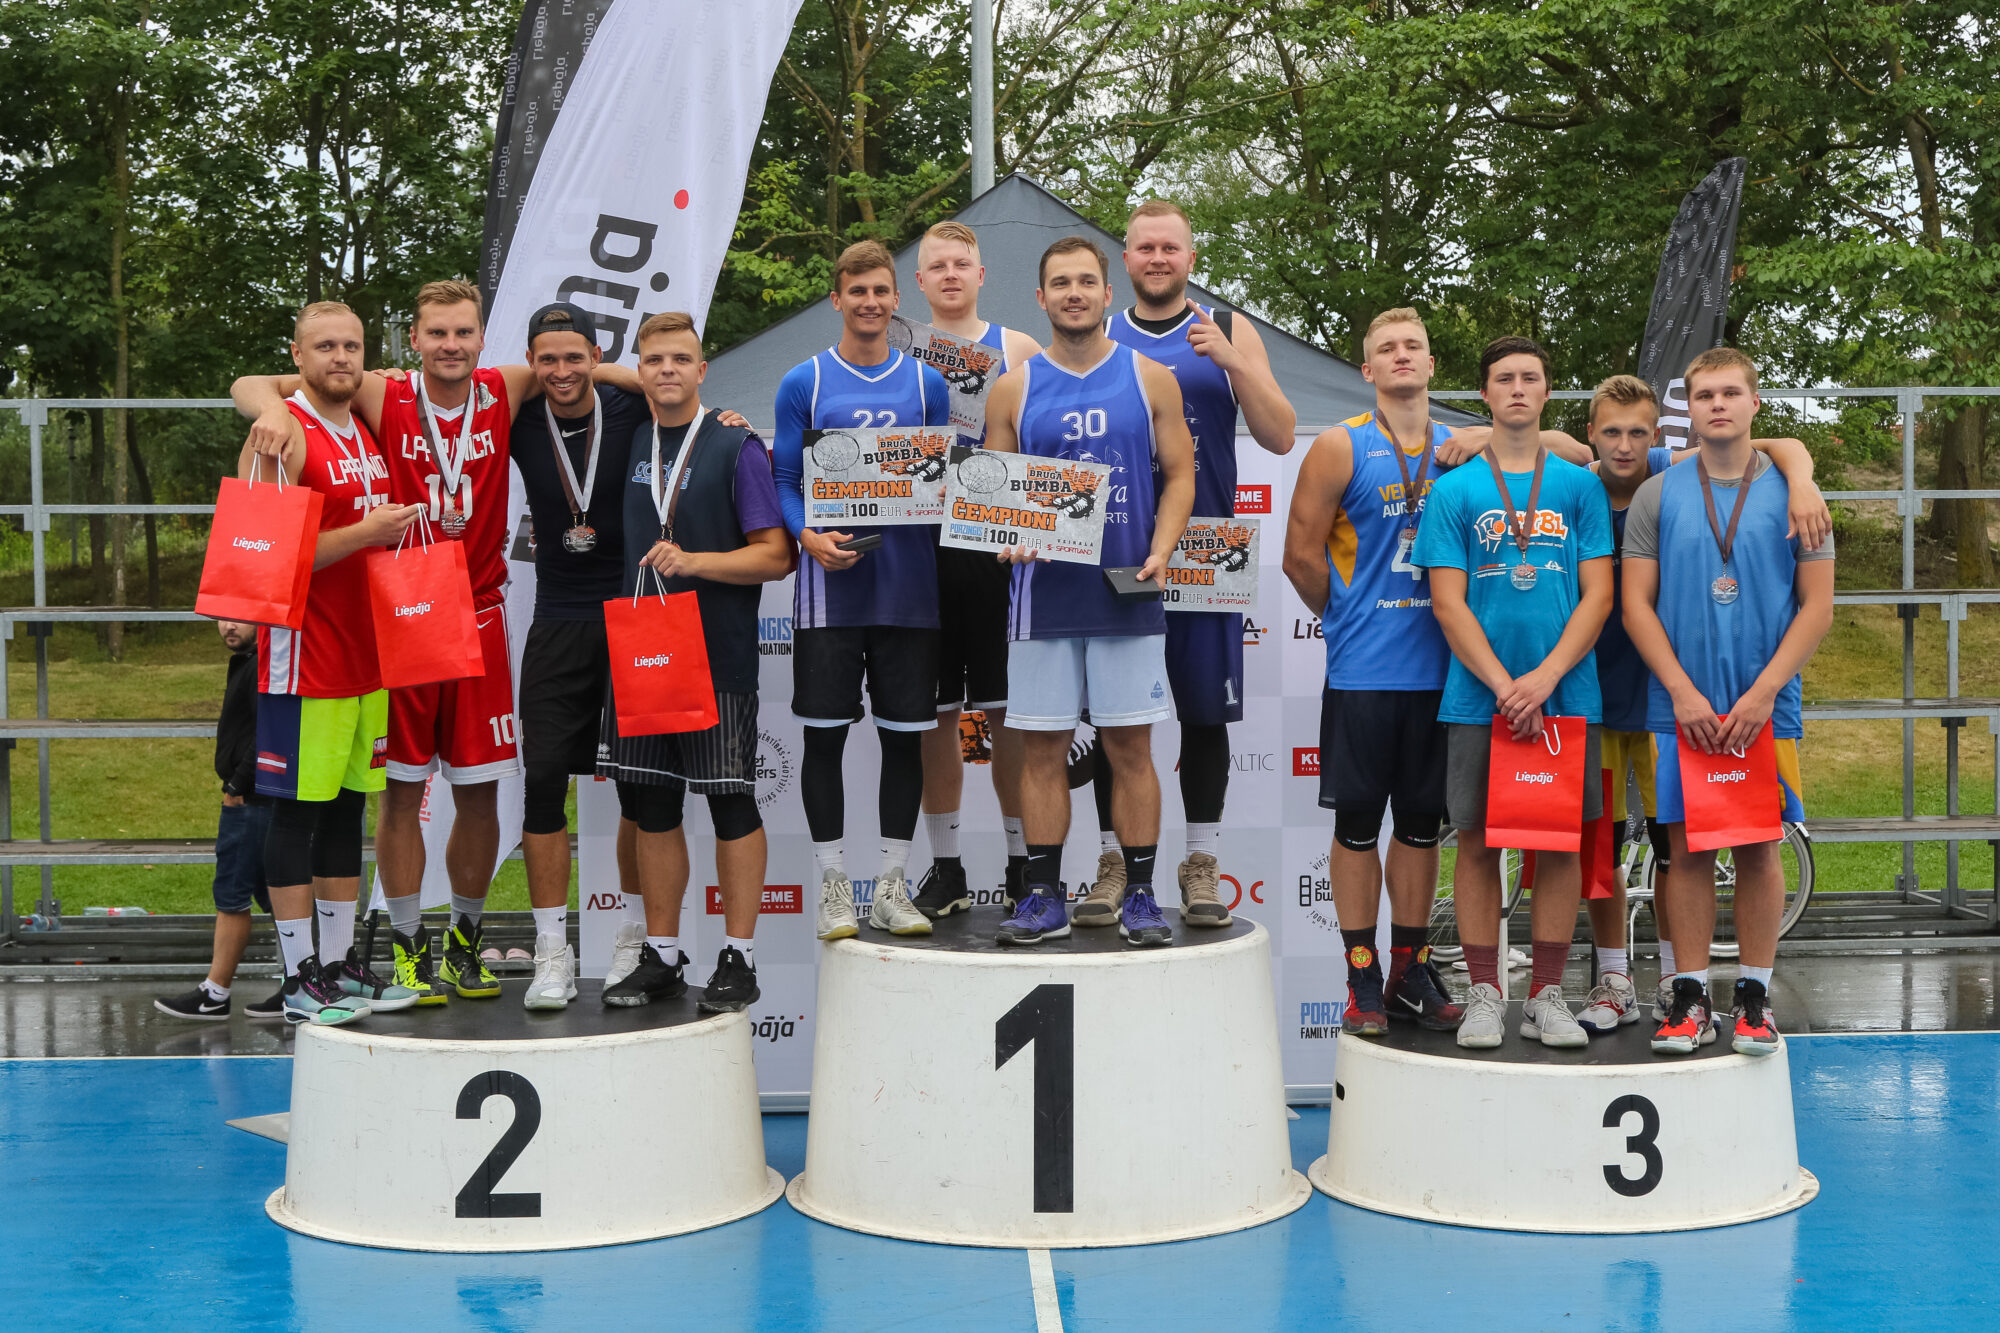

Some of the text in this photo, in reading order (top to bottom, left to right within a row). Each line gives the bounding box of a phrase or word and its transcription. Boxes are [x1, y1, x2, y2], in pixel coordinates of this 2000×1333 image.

[931, 341, 960, 356] BRUGA
[912, 347, 967, 369] BUMBA
[852, 408, 898, 428] 22
[1060, 407, 1108, 442] 30
[880, 440, 913, 448] BRUGA
[863, 447, 924, 465] BUMBA
[1030, 470, 1063, 480] BRUGA
[812, 478, 913, 500] ČEMPIONI
[1010, 480, 1073, 493] BUMBA
[851, 503, 878, 517] 100
[880, 506, 902, 517] EUR
[952, 497, 1057, 532] ČEMPIONI
[990, 529, 1019, 546] 100
[1186, 529, 1217, 538] BRUGA
[232, 536, 274, 552] Liepāja
[1165, 568, 1215, 585] PIONI
[395, 602, 433, 617] Liepāja
[634, 653, 671, 668] Liepāja
[1515, 771, 1556, 785] Liepāja
[1707, 770, 1748, 784] Liepāja
[1301, 1027, 1332, 1040] FAMILY
[995, 984, 1074, 1213] 1
[455, 1069, 542, 1218] 2
[1602, 1094, 1663, 1197] 3
